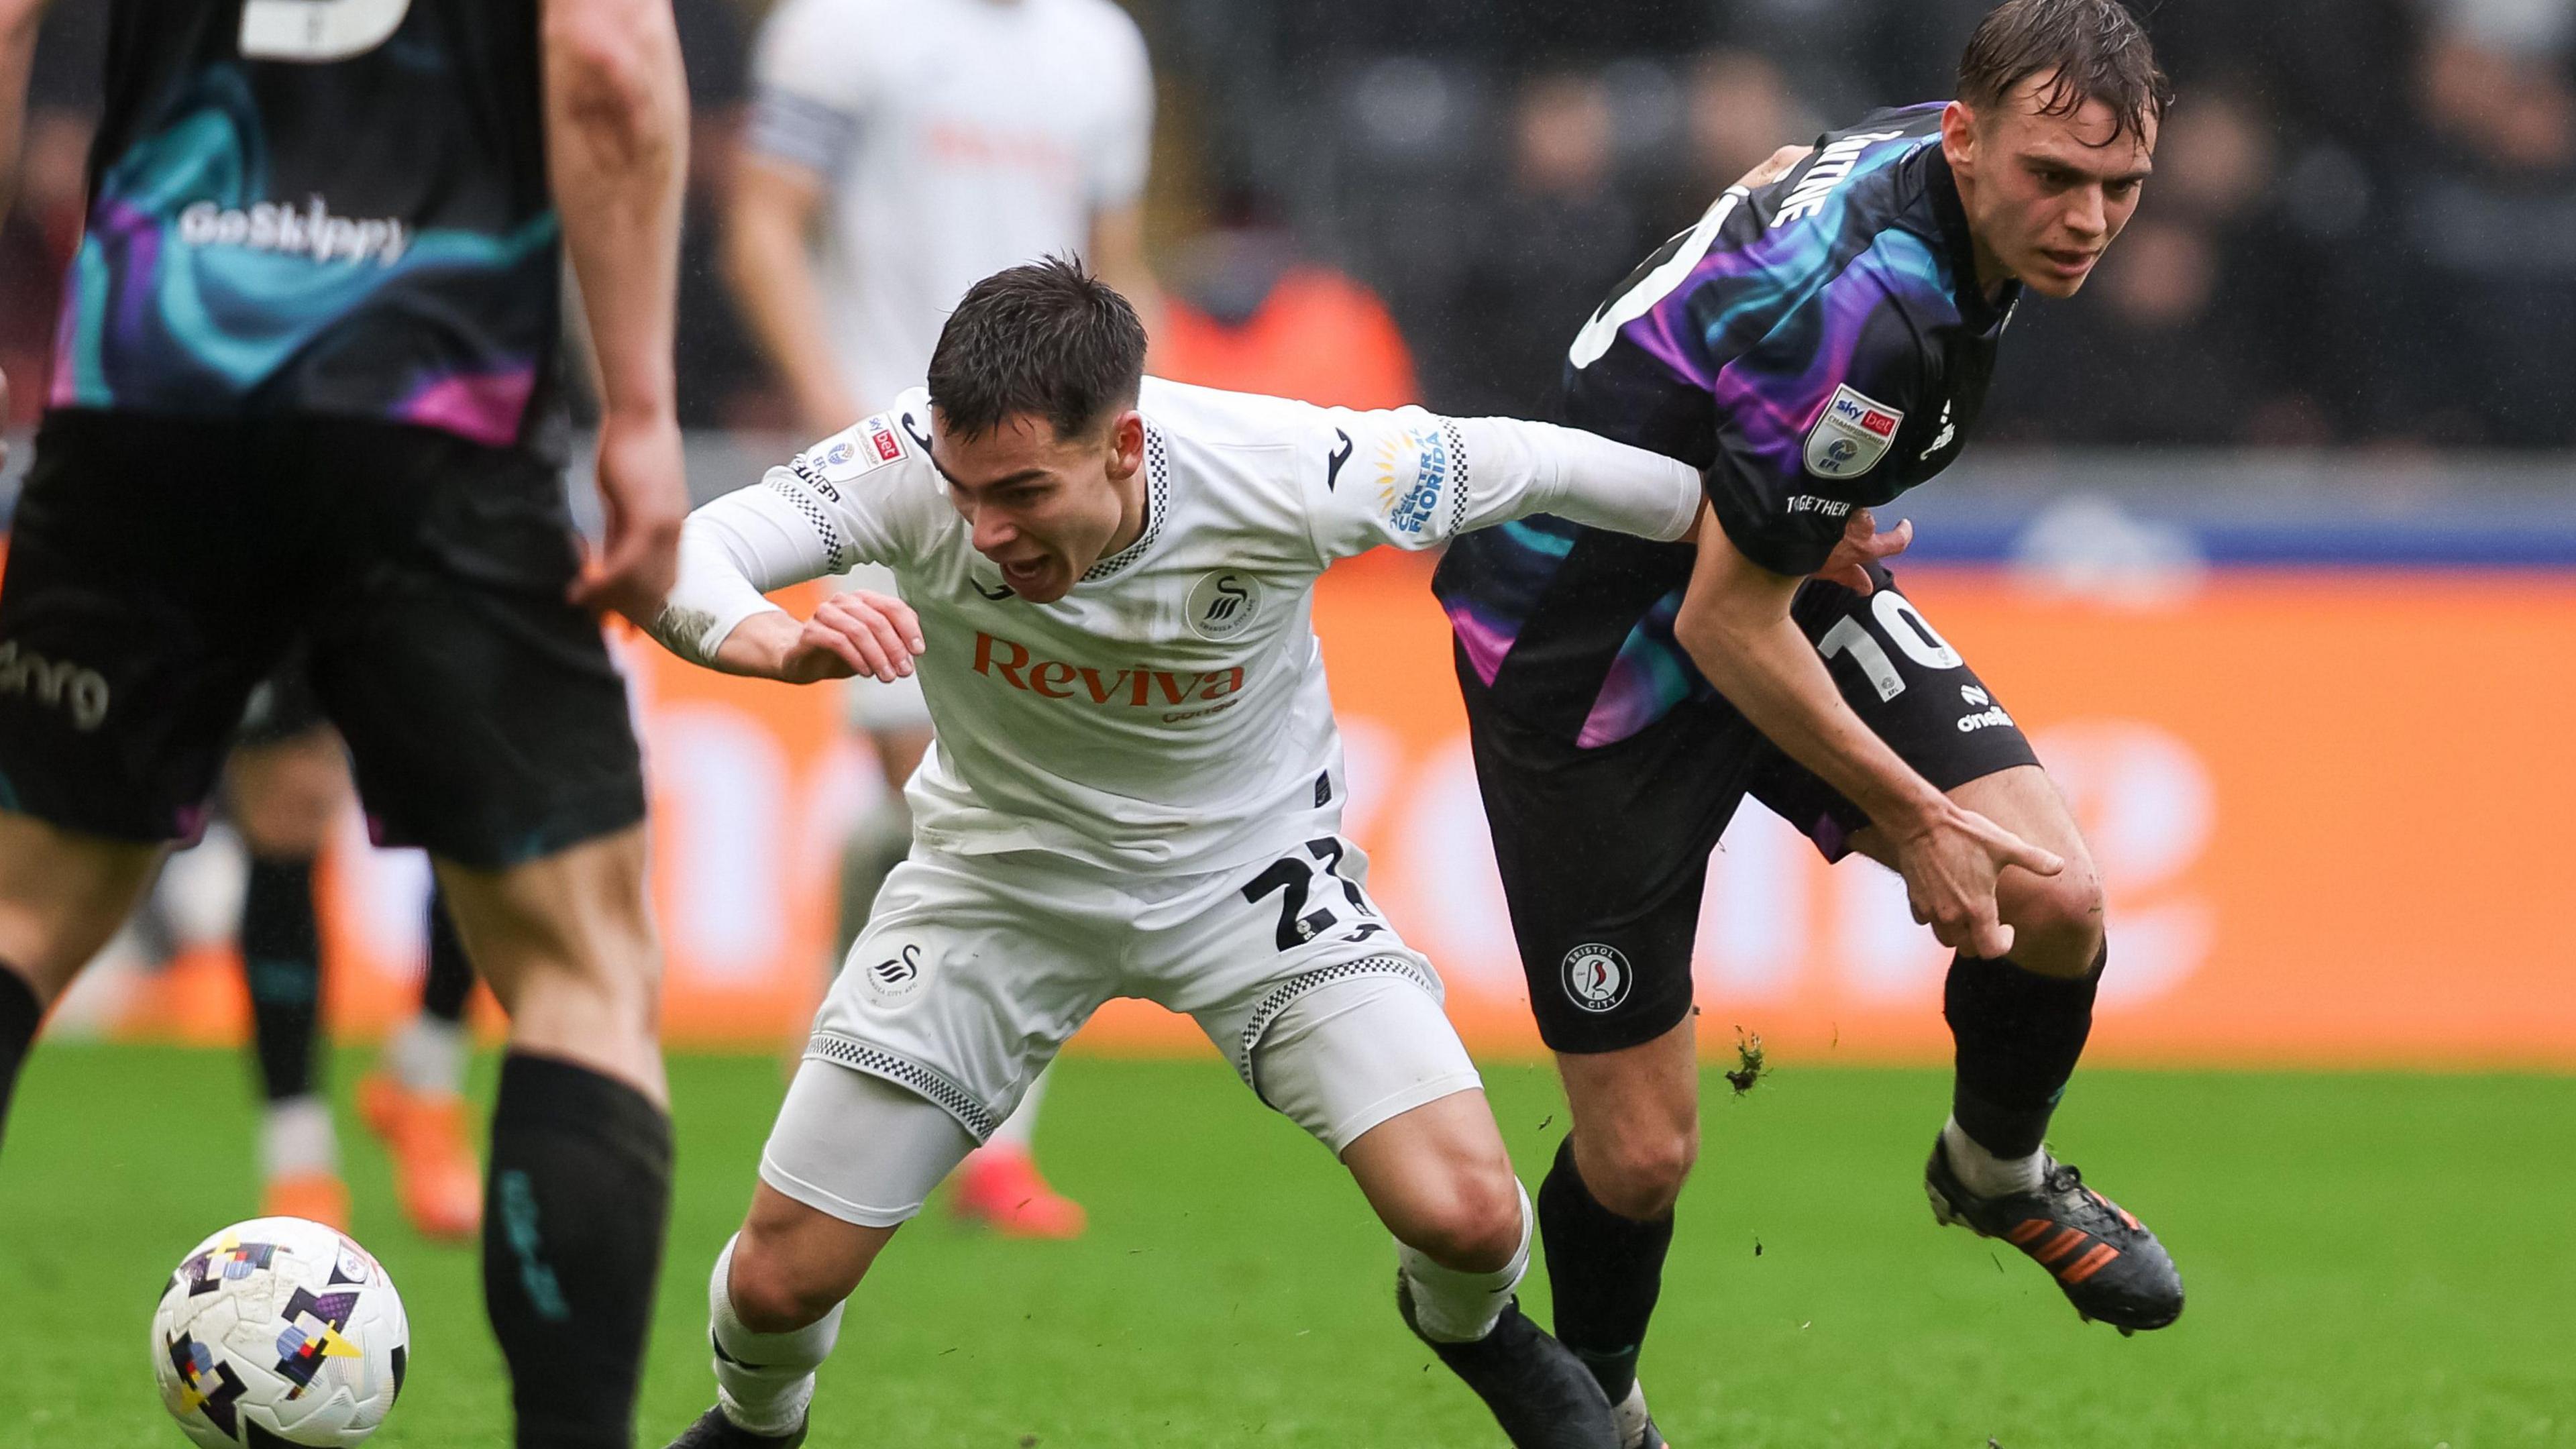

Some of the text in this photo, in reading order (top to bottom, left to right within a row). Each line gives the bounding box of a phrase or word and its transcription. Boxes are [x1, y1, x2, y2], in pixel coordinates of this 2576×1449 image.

[1836, 400, 1890, 431] sky bet
[877, 431, 897, 458] bet
[1819, 458, 1841, 472] EFL
[1408, 431, 1445, 533] FLORIDA
[1817, 590, 1964, 702] 10
[972, 631, 1245, 706] Reviva
[1241, 837, 1377, 952] 27
[1568, 947, 1613, 964] BRISTOL
[1588, 996, 1616, 1008] CITY
